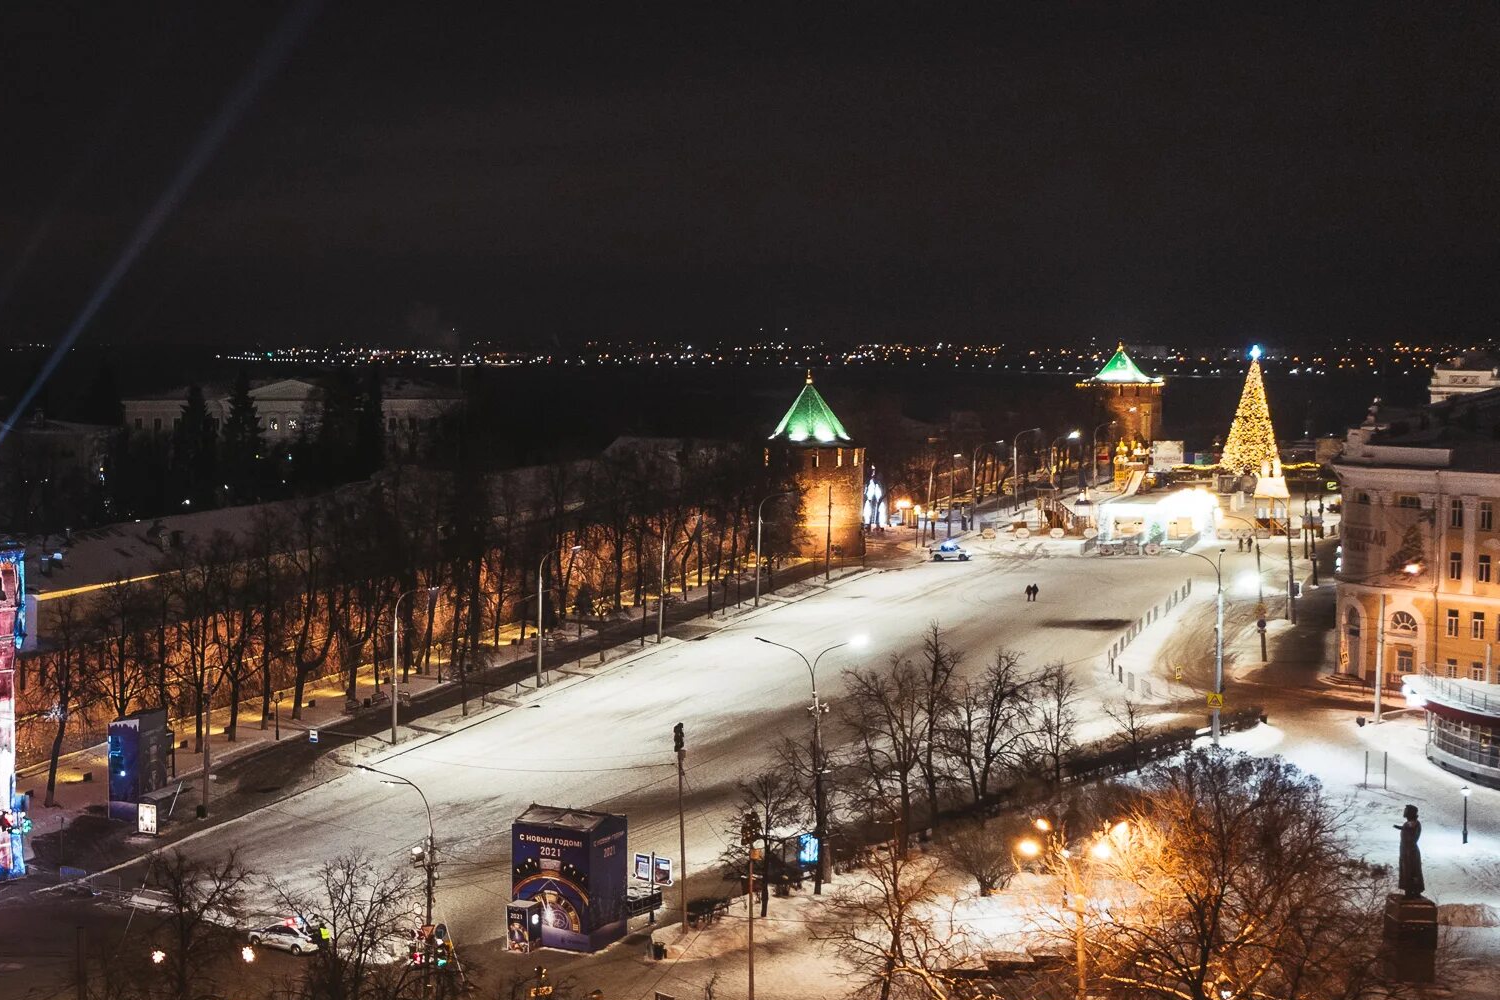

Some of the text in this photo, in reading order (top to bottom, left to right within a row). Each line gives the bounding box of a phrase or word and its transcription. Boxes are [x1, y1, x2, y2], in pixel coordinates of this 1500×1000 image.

[519, 833, 583, 848] С НОВЫМ ГОДОМ!
[540, 846, 561, 857] 2021
[510, 912, 523, 920] 2021
